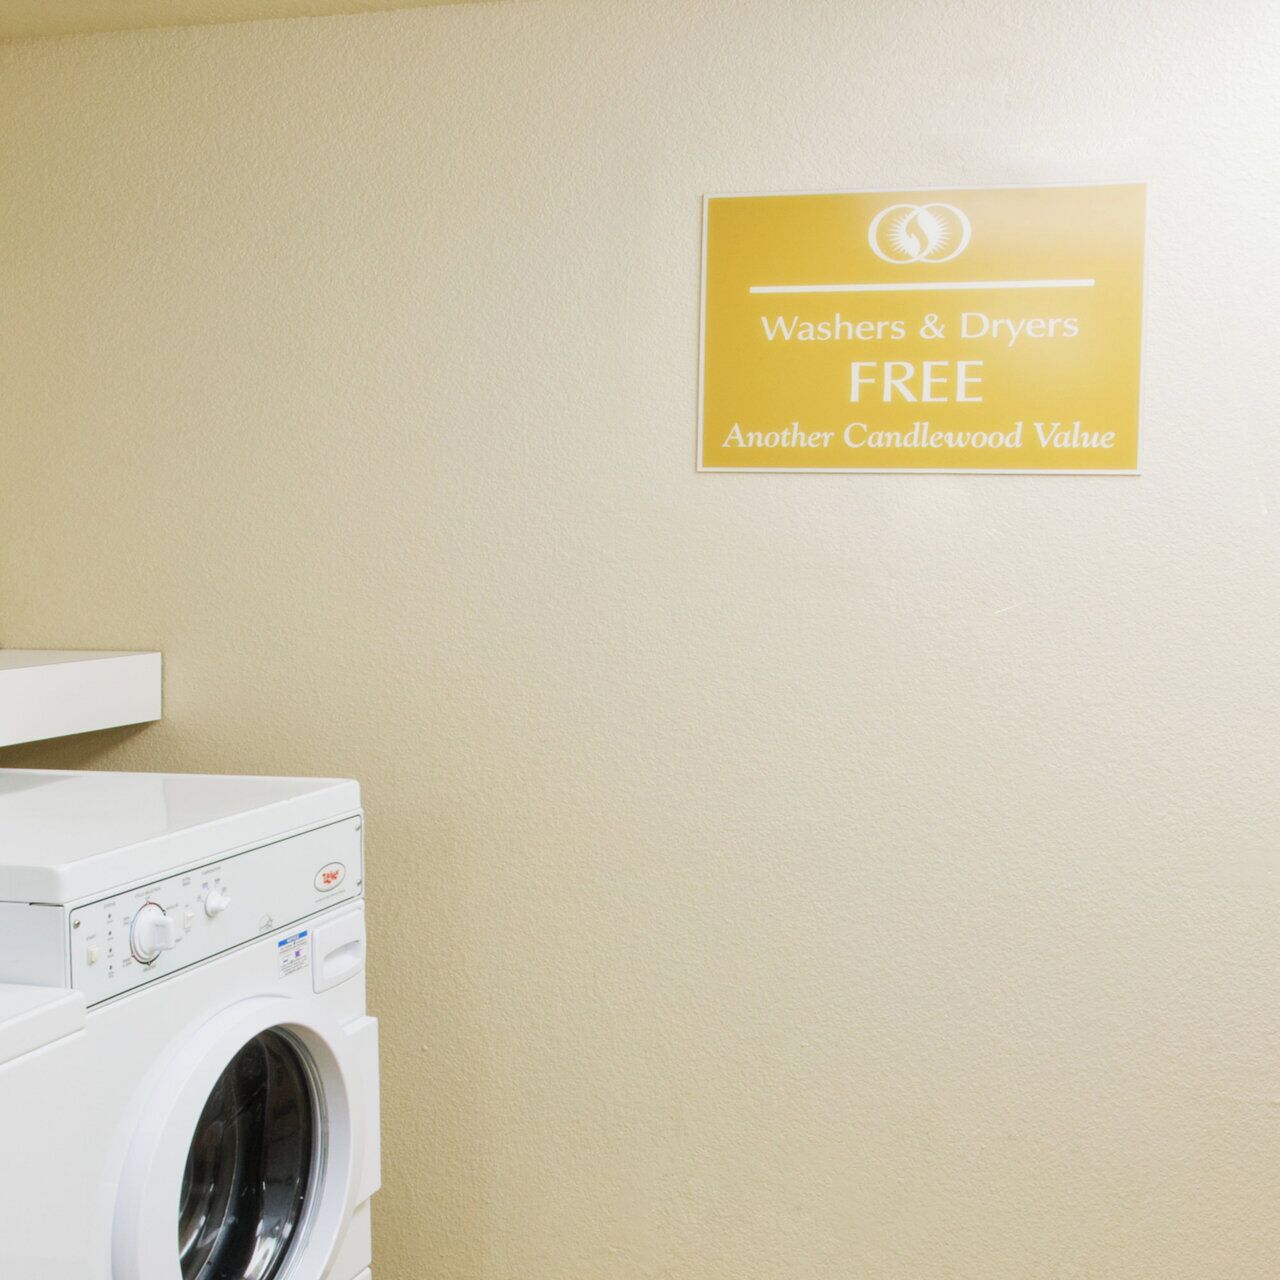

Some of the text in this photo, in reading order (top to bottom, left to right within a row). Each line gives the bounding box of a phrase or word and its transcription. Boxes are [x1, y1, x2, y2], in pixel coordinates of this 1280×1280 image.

[761, 311, 1080, 347] Washers & Dryers
[849, 360, 984, 403] FREE
[722, 422, 1116, 449] Another Candlewood Value
